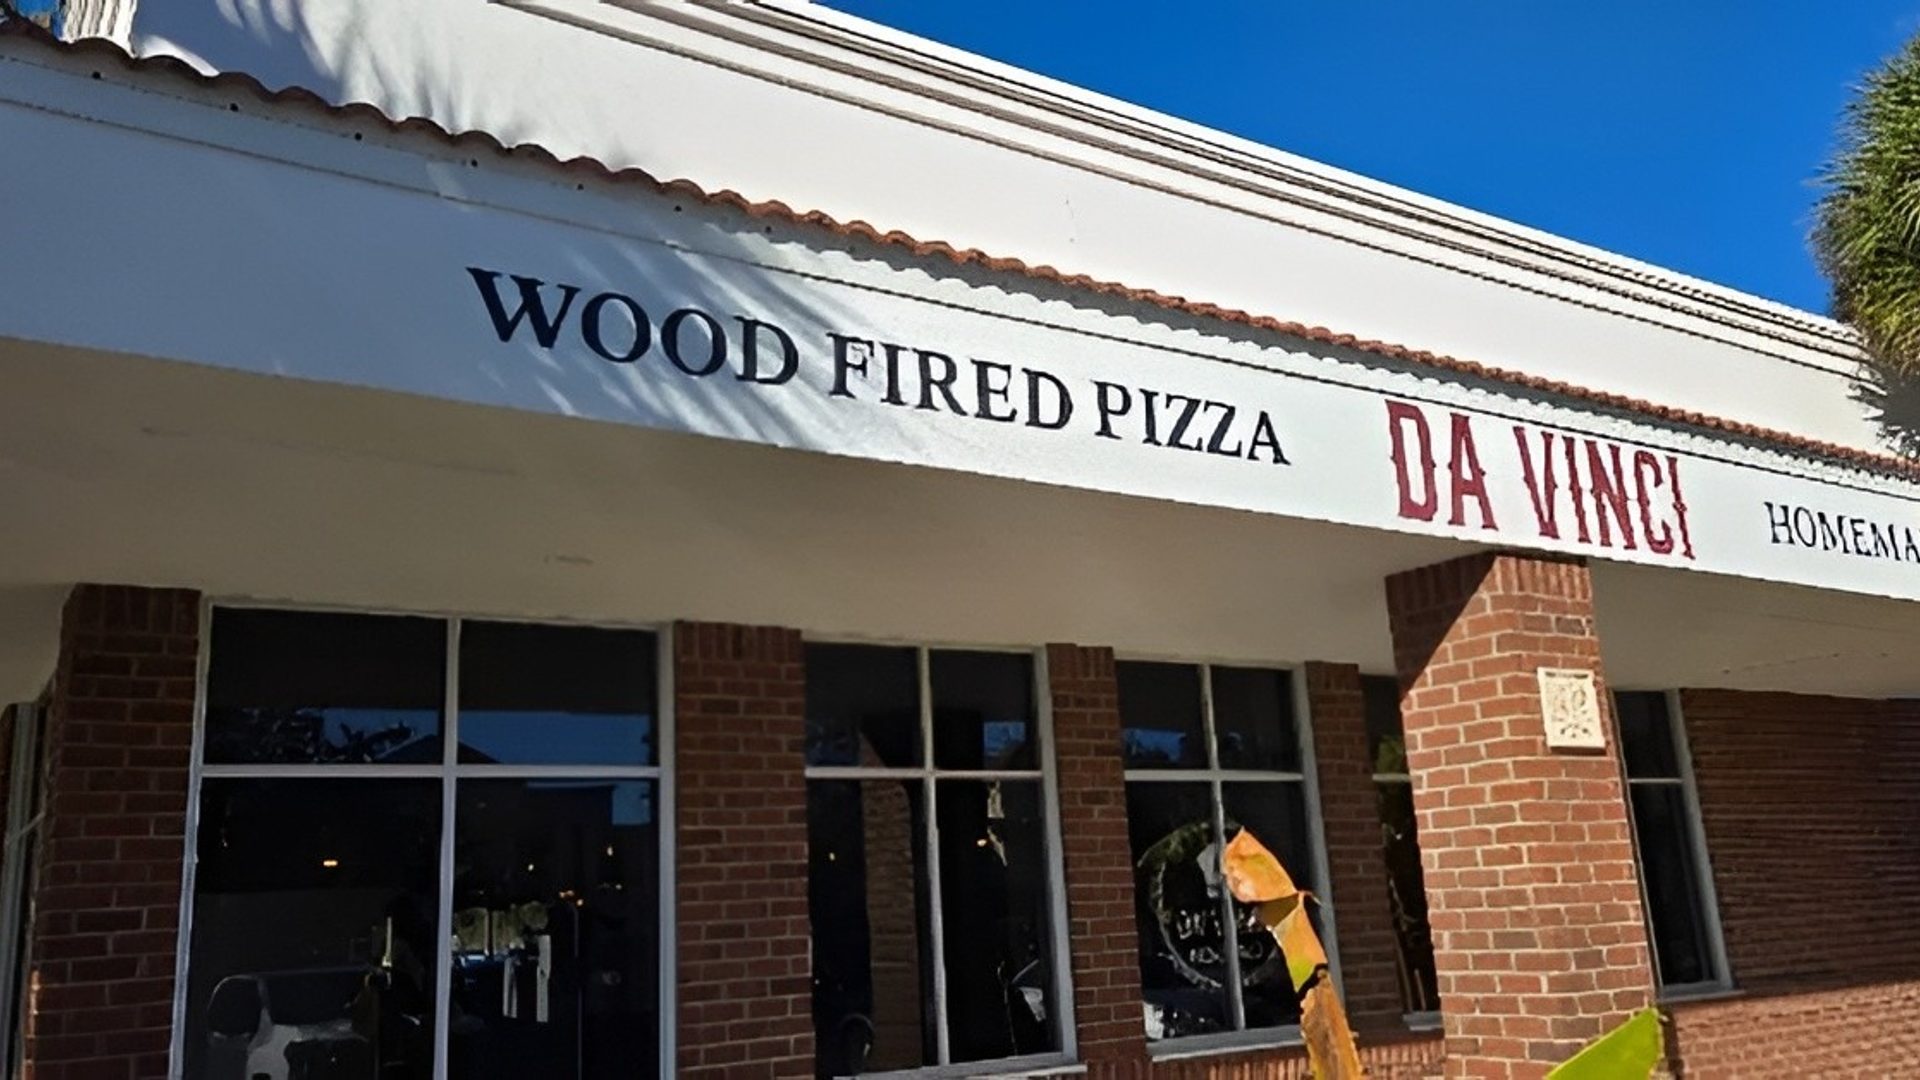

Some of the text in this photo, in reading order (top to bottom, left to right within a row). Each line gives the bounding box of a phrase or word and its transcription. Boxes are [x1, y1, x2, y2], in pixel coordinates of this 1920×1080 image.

[466, 267, 1291, 466] WOOD FIRED PIZZA
[1385, 399, 1696, 560] DA VINCI
